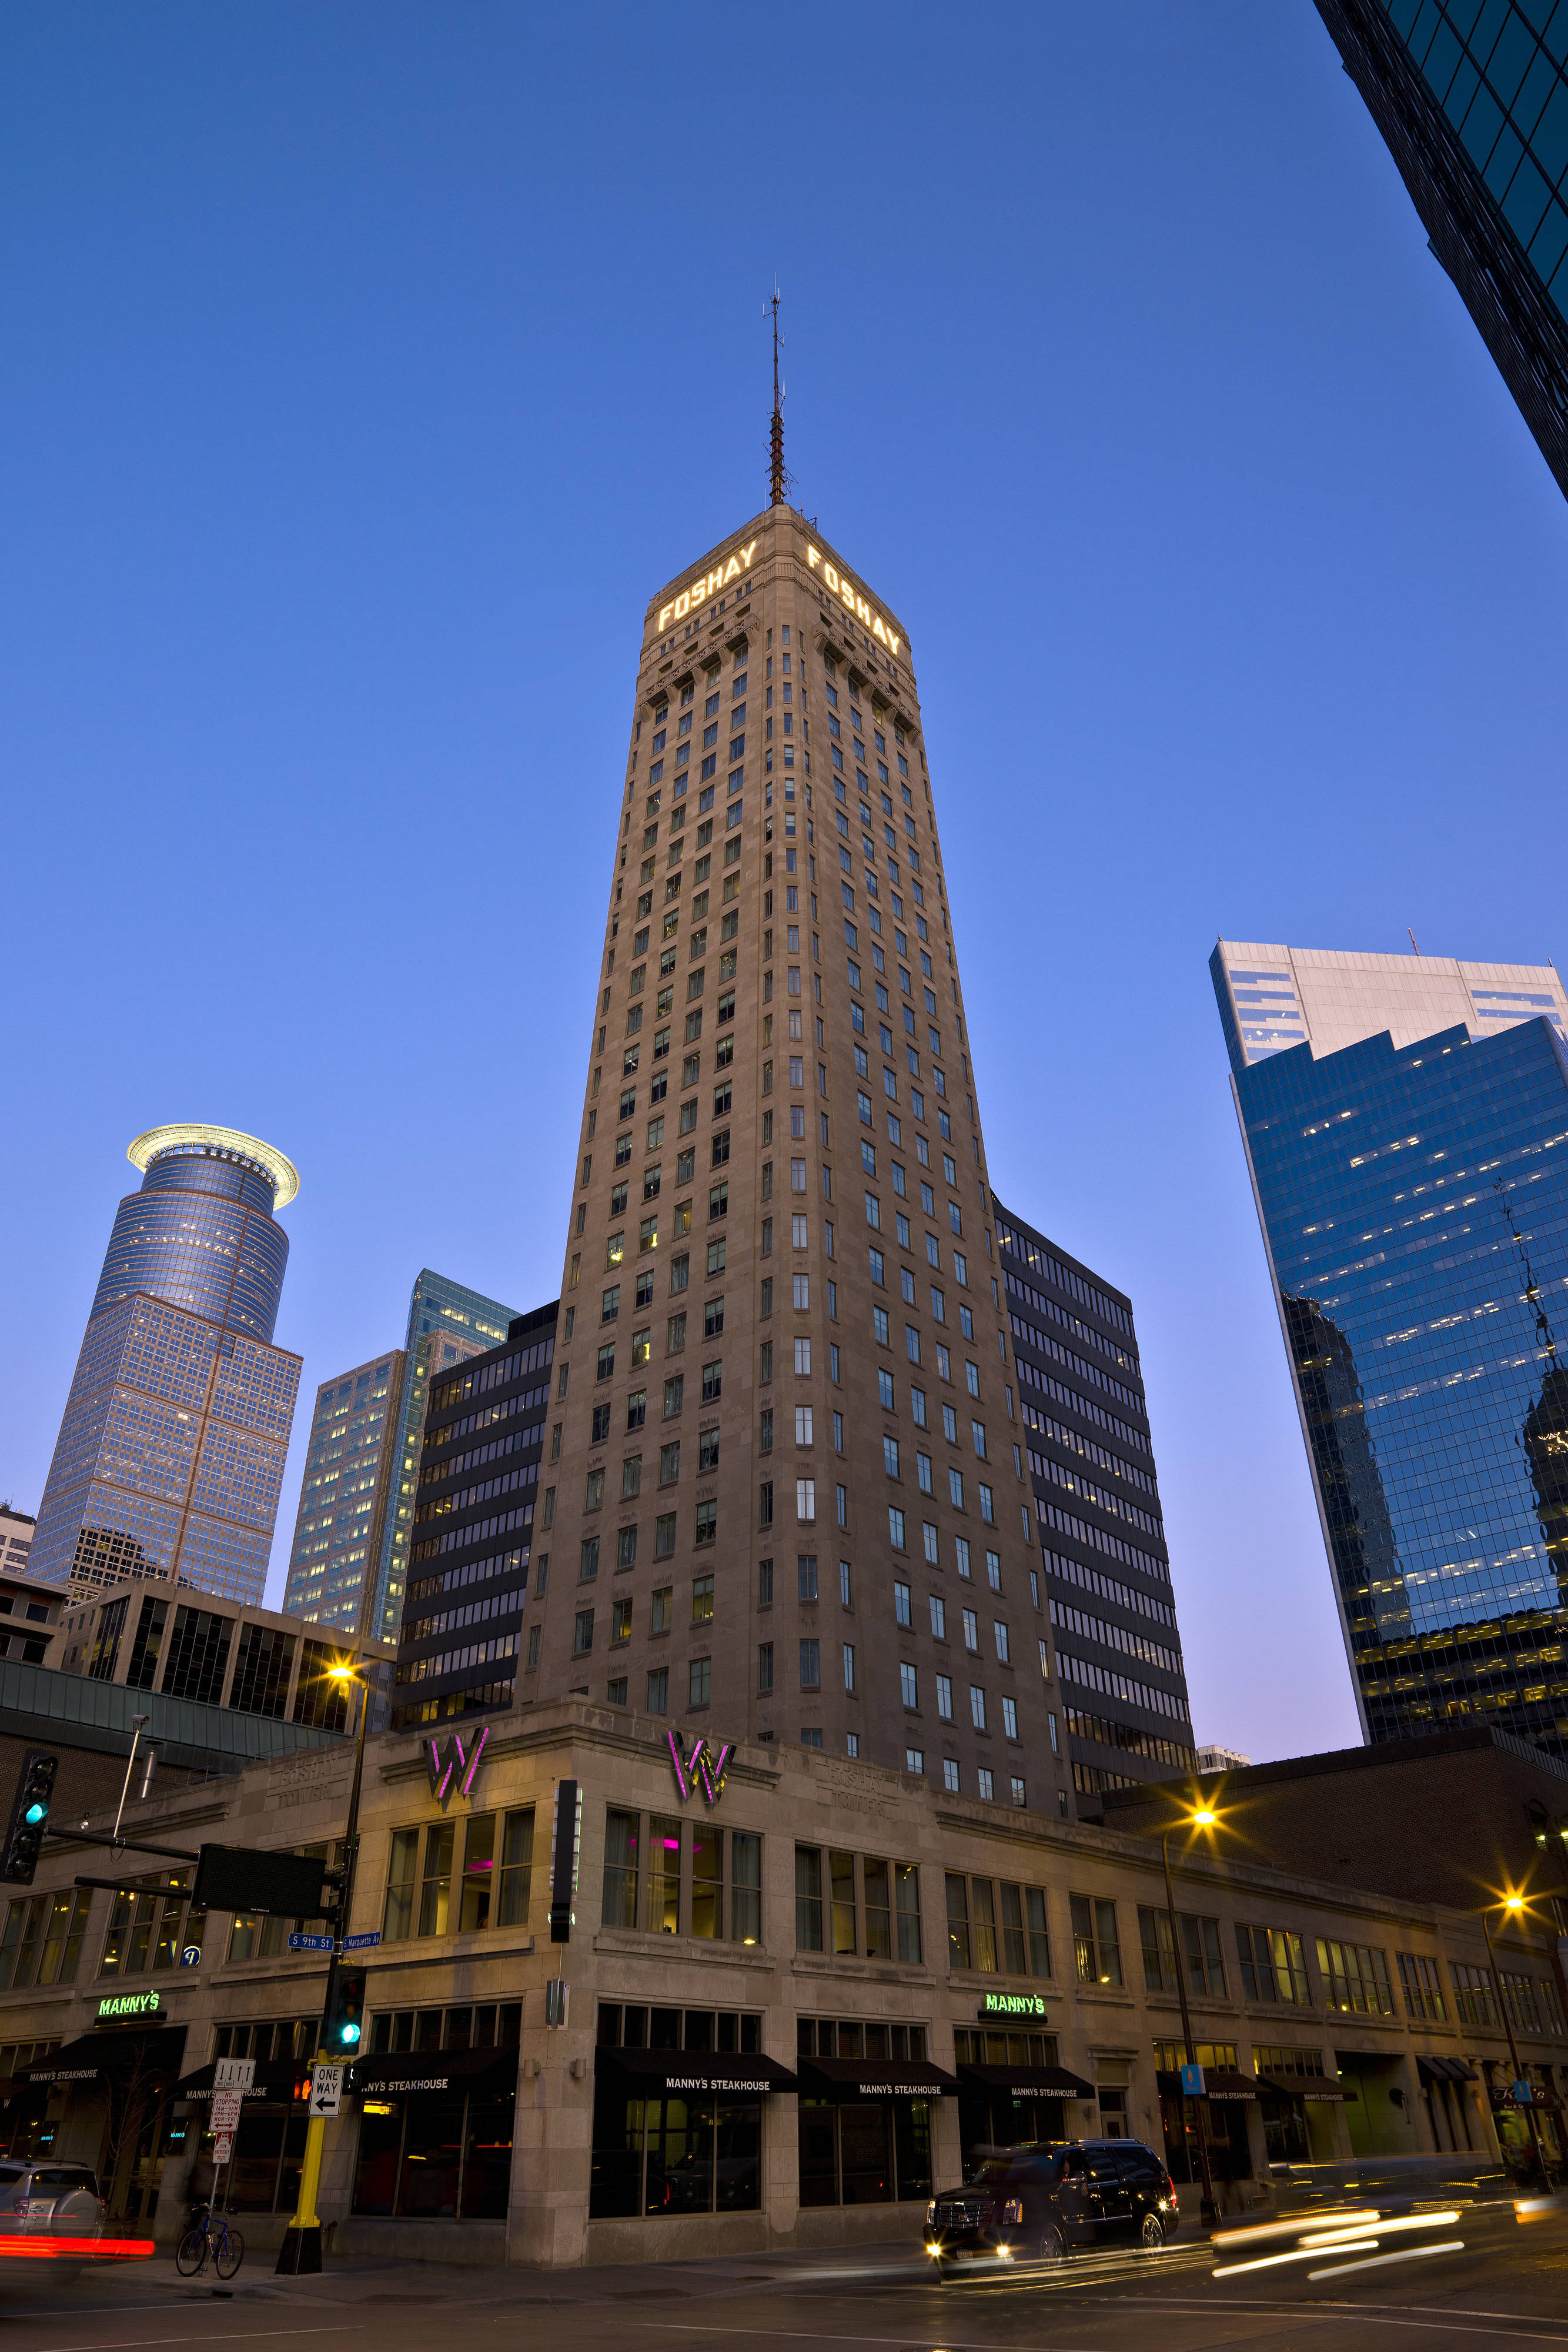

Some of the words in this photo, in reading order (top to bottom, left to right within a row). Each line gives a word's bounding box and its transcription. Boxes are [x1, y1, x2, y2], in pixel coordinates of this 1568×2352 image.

[658, 540, 757, 632] FOSHAY
[808, 544, 900, 655] FOSHAY
[282, 1756, 340, 1786] FOSHAY
[422, 1727, 489, 1807] W
[668, 1730, 737, 1807] W
[829, 1766, 886, 1795] FOSHAY
[278, 1783, 329, 1809] TOWER
[832, 1790, 884, 1817] TOWER
[292, 1936, 298, 1945] S
[303, 1937, 316, 1946] 9th
[321, 1938, 329, 1948] St
[343, 1939, 347, 1947] S
[348, 1936, 372, 1947] Marquette
[373, 1935, 380, 1943] Av
[99, 1990, 159, 2016] MANNY'S
[986, 1994, 1045, 2014] MANNY'S
[29, 2071, 56, 2082] MANNY'S
[57, 2069, 99, 2080] STEAKHOUSE
[319, 2069, 339, 2080] ONE
[666, 2077, 708, 2089] MANNY'S
[711, 2080, 770, 2091] STEAKHOUSE
[316, 2083, 338, 2094] WAY
[388, 2079, 449, 2092] STEAKHOUSE
[860, 2084, 892, 2094] MANNY'S
[895, 2086, 941, 2094] STEAKHOUSE
[1012, 2087, 1038, 2097] MANNY'S
[1039, 2089, 1077, 2097] STEAKHOUSE
